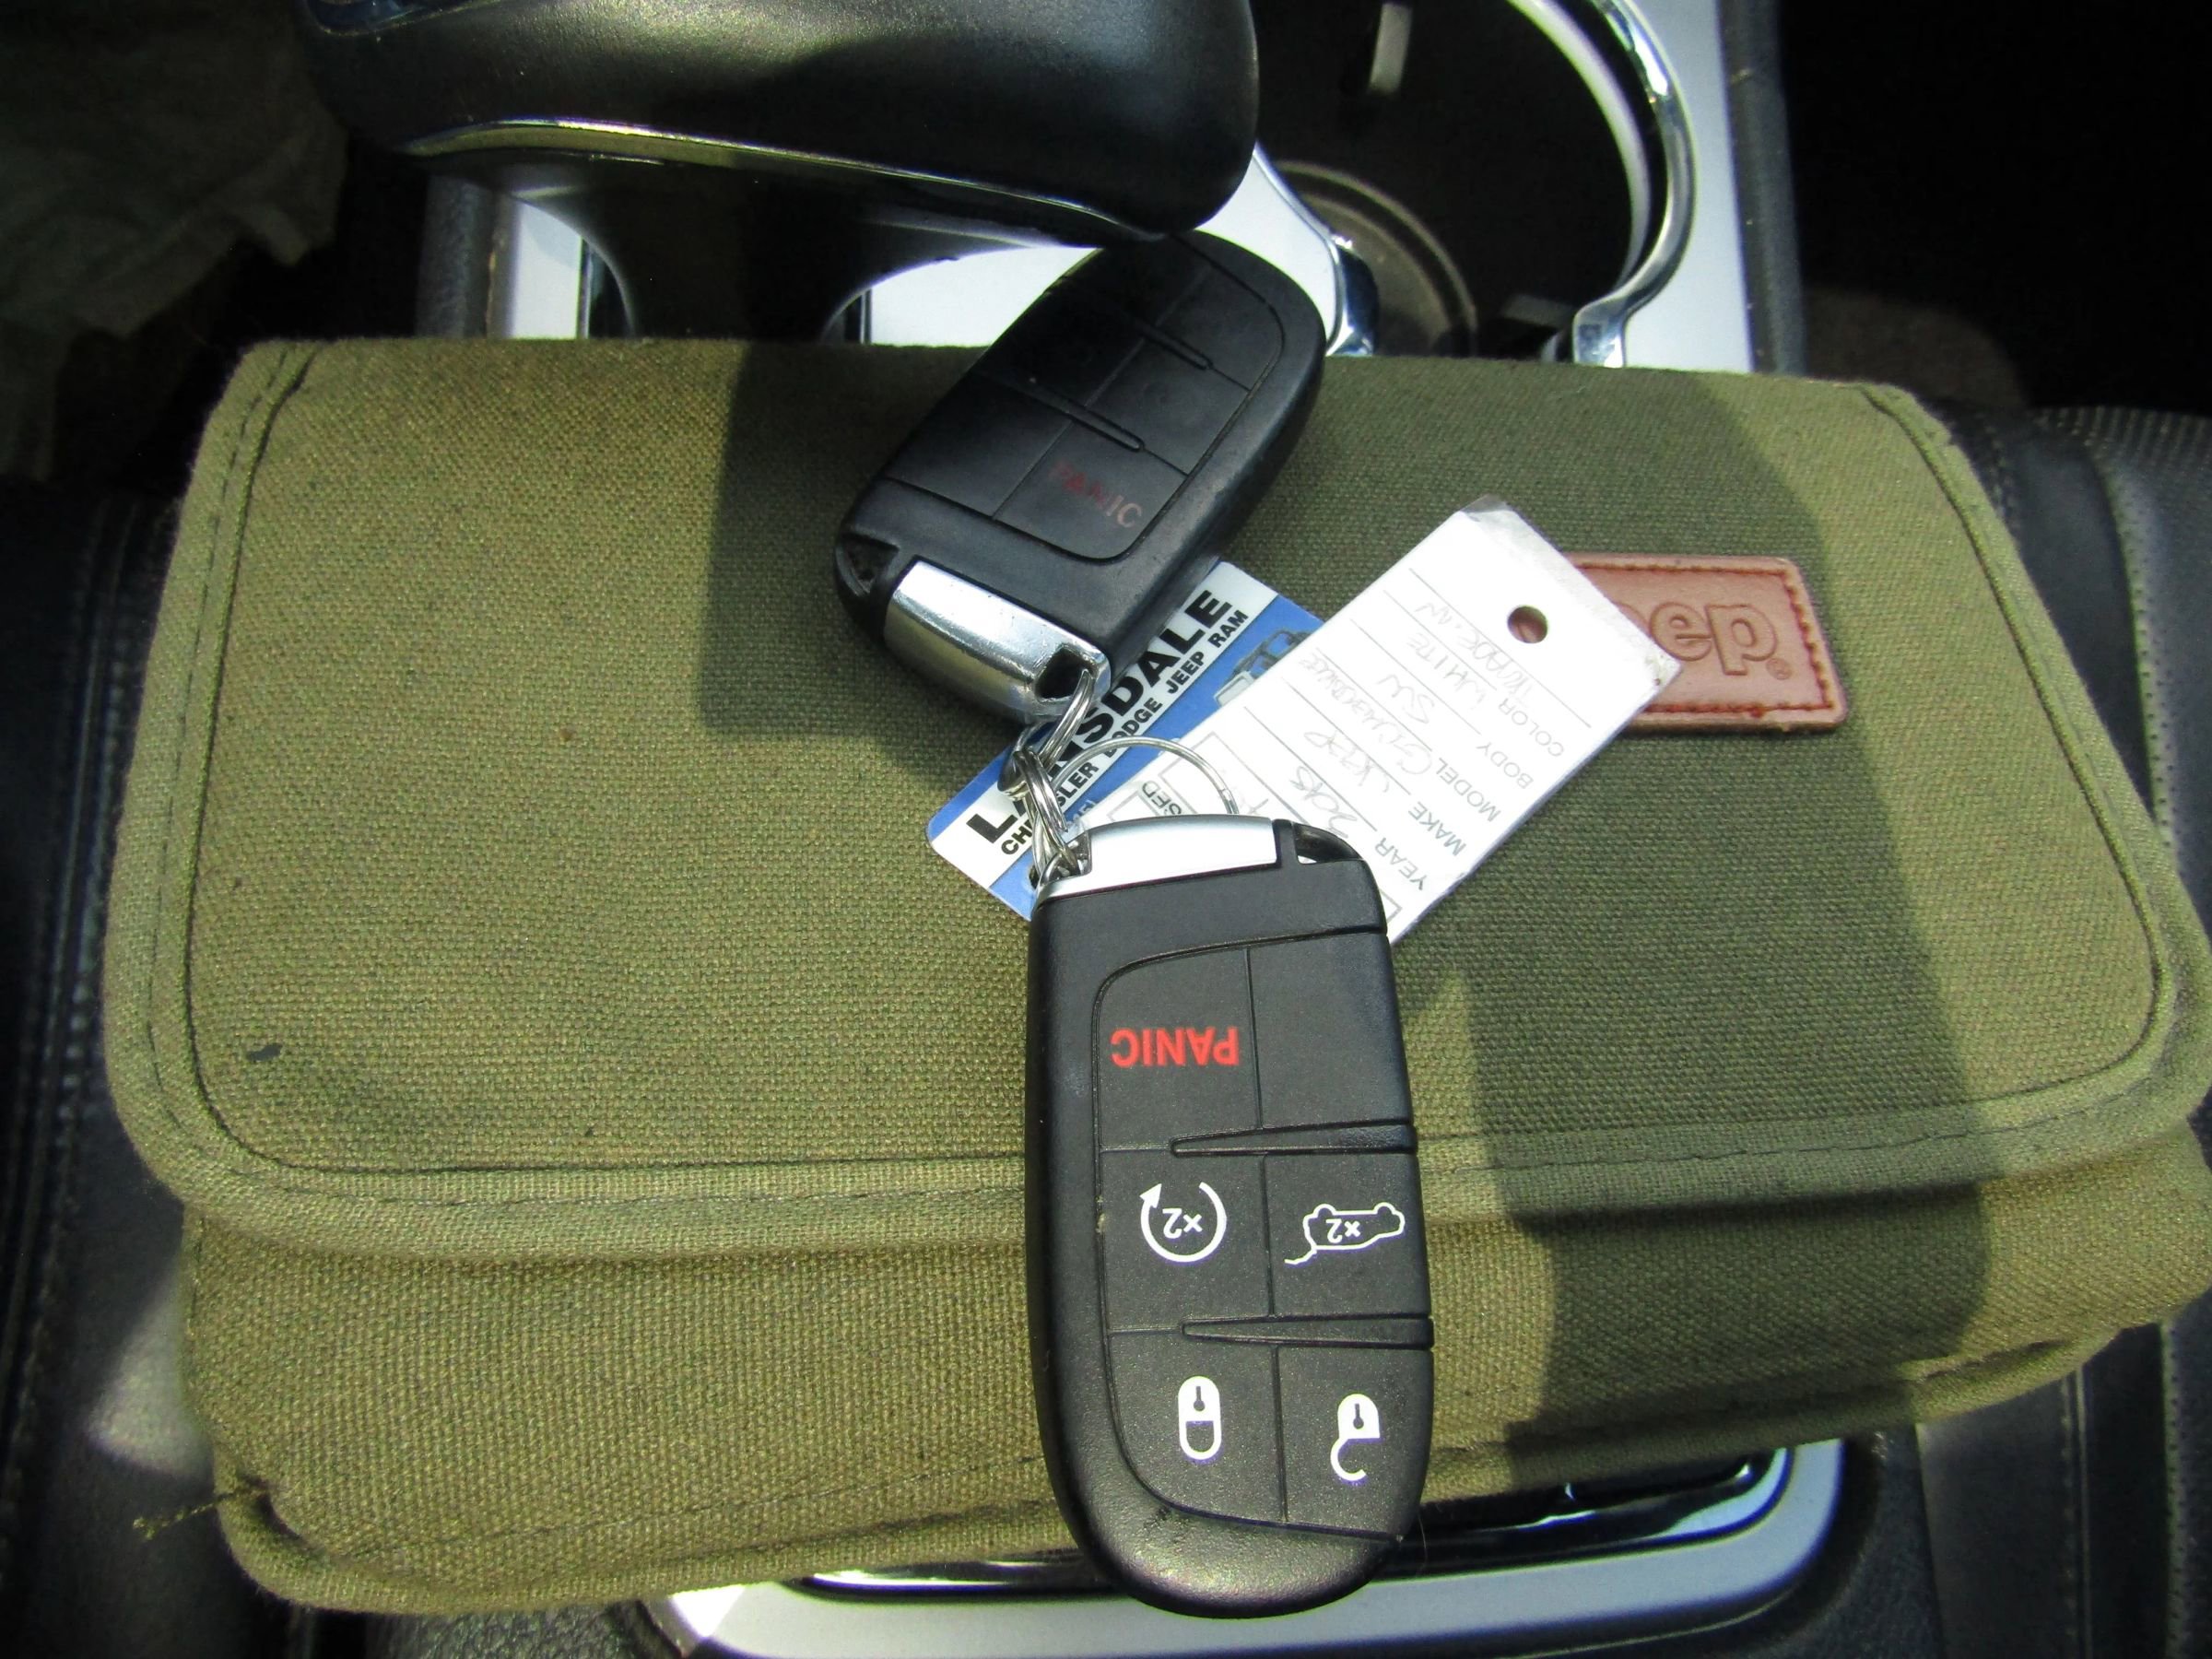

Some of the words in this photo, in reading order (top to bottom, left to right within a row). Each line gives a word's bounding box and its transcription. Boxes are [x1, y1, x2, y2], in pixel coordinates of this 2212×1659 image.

[1167, 652, 1206, 694] JEEP
[1207, 610, 1249, 647] RAM
[1498, 698, 1565, 757] COLOR
[1434, 757, 1501, 822] MODEL
[1476, 740, 1535, 791] BODY
[1142, 779, 1182, 816] SED
[1407, 801, 1467, 857] MAKE
[1374, 837, 1429, 891] YEAR
[1110, 1027, 1240, 1067] PANIC
